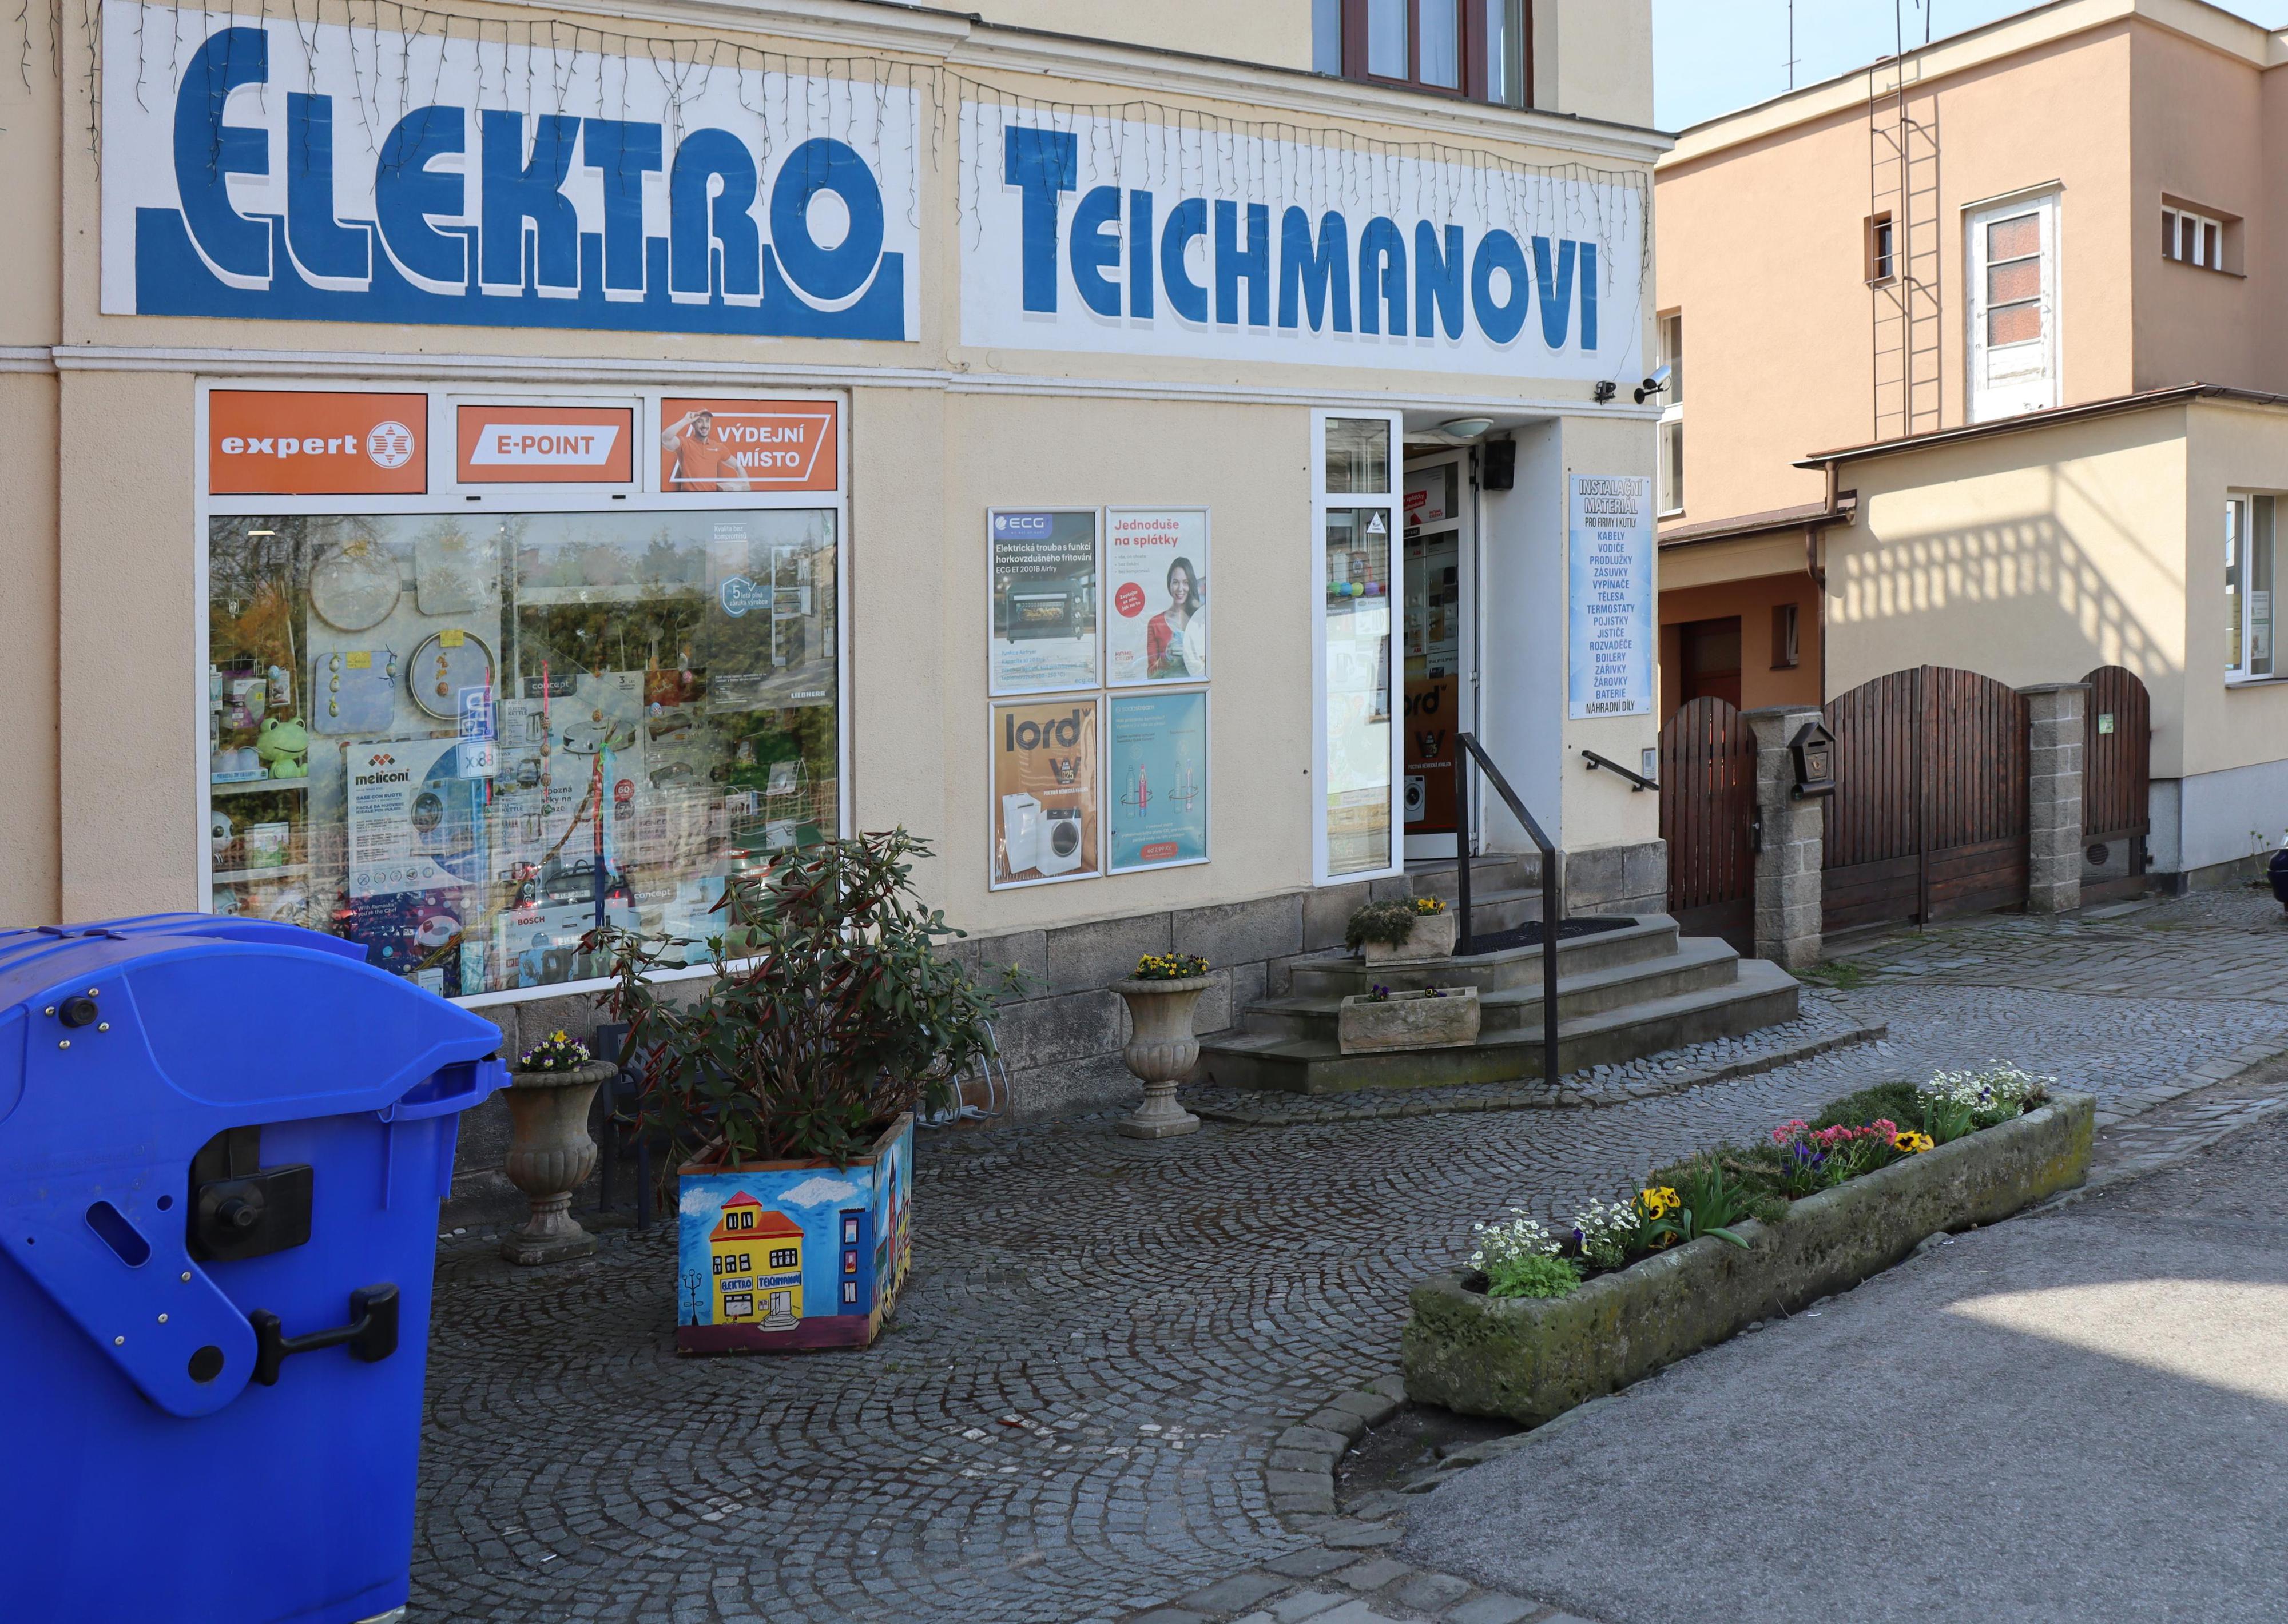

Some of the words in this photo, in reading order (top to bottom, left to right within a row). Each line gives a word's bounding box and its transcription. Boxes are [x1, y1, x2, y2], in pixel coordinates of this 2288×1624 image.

[174, 27, 884, 306] ELEKTRO
[1005, 125, 1598, 351] TEICHMANOVI
[717, 423, 804, 443] VÝDEJNÍ
[221, 435, 357, 458] expert
[498, 436, 594, 455] E-POINT
[737, 448, 800, 467] MÍSTO
[1579, 478, 1643, 496] INSTALAČNÍ
[1584, 496, 1638, 514] MATERIÁL
[1010, 518, 1044, 528] ECG
[1114, 519, 1179, 530] Jednoduše
[1585, 517, 1596, 527] PRO
[1598, 518, 1614, 527] FIRMY
[1620, 518, 1636, 527] KUTILY
[1115, 537, 1130, 545] na
[1133, 534, 1178, 548] splátky
[1598, 531, 1625, 540] KABELY
[996, 543, 1035, 552] Elektrická
[1036, 543, 1062, 551] trouba
[1068, 542, 1091, 551] funkcí
[1598, 542, 1624, 552] VODIČE
[996, 554, 1060, 563] horkovzdušného
[1062, 553, 1092, 562] fritování
[1590, 554, 1632, 564] PRODLUŽKY
[1041, 565, 1057, 573] Airfry
[1594, 567, 1628, 577] ZÁSUVKY
[1592, 578, 1630, 589] VYPÍNAČE
[733, 585, 740, 599] 5
[752, 592, 763, 600] plná
[1598, 591, 1624, 601] TĚLESA
[1587, 604, 1635, 614] TERMOSTATY
[1594, 616, 1628, 626] POJISTKY
[1598, 627, 1624, 638] JISTIČE
[1590, 639, 1632, 651] ROZVADĚČE
[1596, 652, 1626, 663] BOILERY
[1595, 664, 1626, 675] ZÁŘIVKY
[1594, 676, 1628, 687] ŽÁROVKY
[791, 691, 825, 699] LIEBHERR
[1596, 688, 1626, 699] BATERIE
[1586, 699, 1621, 714] NÁHRADNÍ
[1622, 699, 1635, 711] DÍLY
[1006, 709, 1080, 752] lord
[356, 768, 410, 786] meliconi
[634, 888, 671, 899] concept
[518, 916, 545, 926] BOSCH
[722, 1279, 752, 1291] ELEKTRO
